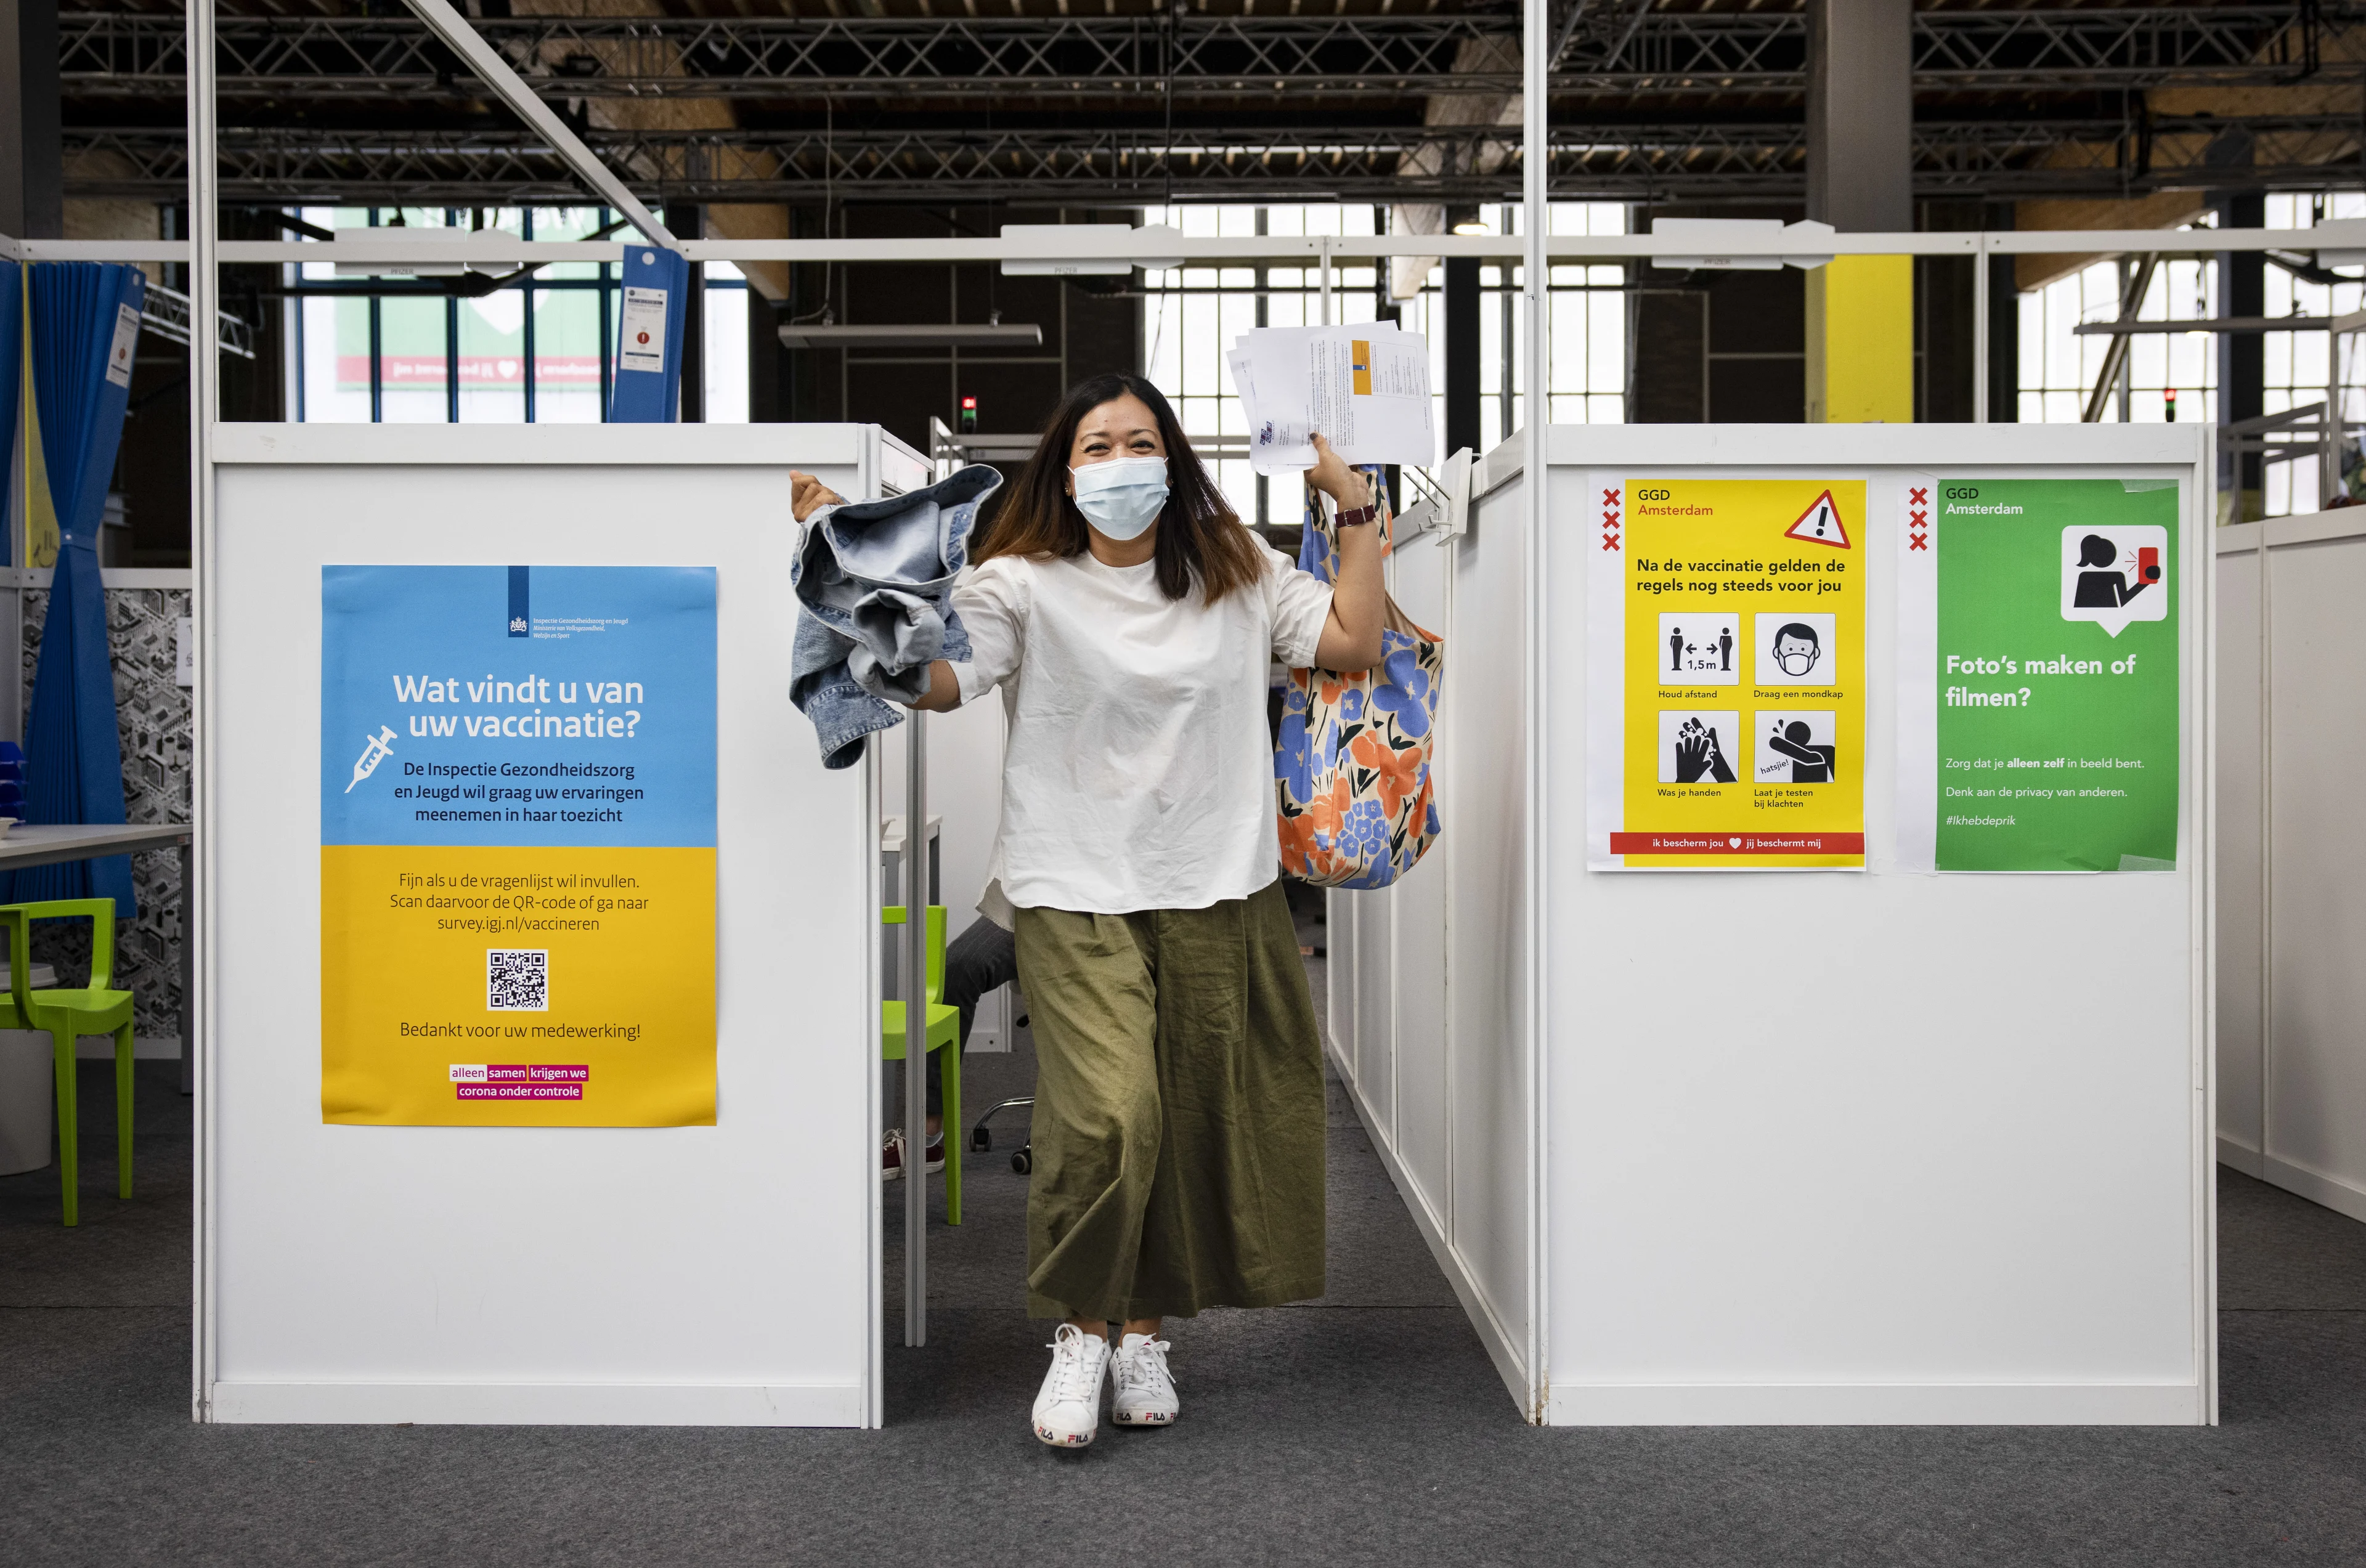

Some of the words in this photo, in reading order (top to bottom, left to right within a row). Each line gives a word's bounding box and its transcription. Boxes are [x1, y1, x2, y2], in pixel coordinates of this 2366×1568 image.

[1638, 489, 1670, 500] GGD
[1946, 488, 1979, 499] GGD
[1638, 504, 1713, 516] Amsterdam
[1945, 502, 2023, 514] Amsterdam
[1637, 559, 1659, 572] Na
[1663, 558, 1683, 572] de
[1688, 559, 1763, 572] vaccinatie
[1768, 559, 1821, 575] gelden
[1826, 559, 1845, 572] de
[1636, 578, 1683, 595] regels
[1688, 582, 1717, 595] nog
[1723, 578, 1773, 591] steeds
[1778, 582, 1814, 591] voor
[1816, 579, 1841, 595] jou
[558, 617, 605, 626] Gezondheidszorg
[566, 624, 606, 633] Volksgezondheid,
[2025, 654, 2102, 674] maken
[2110, 654, 2137, 675] of
[392, 675, 460, 702] Wat
[466, 674, 551, 704] vindt
[559, 682, 577, 704] u
[585, 682, 643, 704] van
[1658, 690, 1682, 698] Houd
[1685, 690, 1717, 698] afstand
[1754, 690, 1781, 700] Draag
[1802, 690, 1844, 700] mondkap
[1945, 686, 2031, 707] filmen?
[410, 716, 458, 737] uw
[463, 709, 641, 738] vaccinatie?
[404, 762, 424, 776] De
[428, 762, 497, 779] Inspectie
[500, 763, 635, 780] Gezondheidszorg
[1760, 758, 1789, 774] hatsjie!
[1945, 758, 1970, 771] Zorg
[1974, 758, 1991, 768] dat
[1993, 758, 2004, 770] je
[2006, 758, 2041, 768] alleen
[2043, 758, 2065, 768] zelf
[2067, 758, 2077, 768] in
[2080, 758, 2112, 768] beeld
[2115, 758, 2145, 768] bent.
[394, 787, 413, 798] en
[415, 784, 460, 802] Jeugd
[463, 785, 486, 798] wil
[489, 789, 532, 802] graag
[535, 789, 559, 799] uw
[561, 785, 643, 803] ervaringen
[1677, 789, 1686, 798] je
[1754, 789, 1773, 797] Laat
[1774, 789, 1783, 798] je
[1946, 786, 1974, 797] Denk
[1998, 786, 2013, 797] de
[2015, 787, 2054, 799] privacy
[2079, 786, 2128, 797] anderen.
[1754, 800, 1765, 810] bij
[415, 811, 502, 821] meenemen
[505, 807, 519, 821] in
[523, 807, 558, 822] haar
[560, 808, 623, 822] toezicht
[1946, 815, 2016, 828] #Ikhebdeprik
[1653, 839, 1661, 847] ik
[1663, 839, 1707, 847] bescherm
[1709, 839, 1724, 849] jou
[1746, 839, 1754, 849] jij
[1757, 839, 1805, 847] beschermt
[1807, 839, 1821, 849] mij
[400, 872, 423, 890] Fijn
[426, 873, 445, 887] als
[449, 877, 457, 887] u
[460, 874, 478, 887] de
[481, 874, 554, 891] vragenlijst
[556, 874, 577, 887] wil
[580, 874, 640, 888] invullen.
[390, 895, 423, 908] Scan
[426, 894, 490, 908] daarvoor
[492, 895, 510, 909] de
[513, 895, 576, 912] QR-code
[579, 895, 595, 909] of
[596, 899, 613, 912] ga
[617, 899, 649, 909] naar
[437, 916, 599, 933] survey.igj.nl/vaccineren
[400, 1022, 463, 1037] Bedankt
[466, 1026, 501, 1038] voor
[505, 1026, 527, 1038] uw
[531, 1023, 641, 1041] medewerking!
[452, 1067, 484, 1078] alleen
[489, 1070, 526, 1078] samen
[531, 1067, 568, 1081] krijgen
[569, 1070, 587, 1078] we
[459, 1088, 497, 1096] corona
[499, 1086, 532, 1096] onder
[534, 1086, 580, 1096] controle
[1116, 1412, 1132, 1421] FILA
[1145, 1412, 1165, 1421] FILA
[1038, 1426, 1053, 1440] FILA
[1067, 1434, 1088, 1443] FILA
